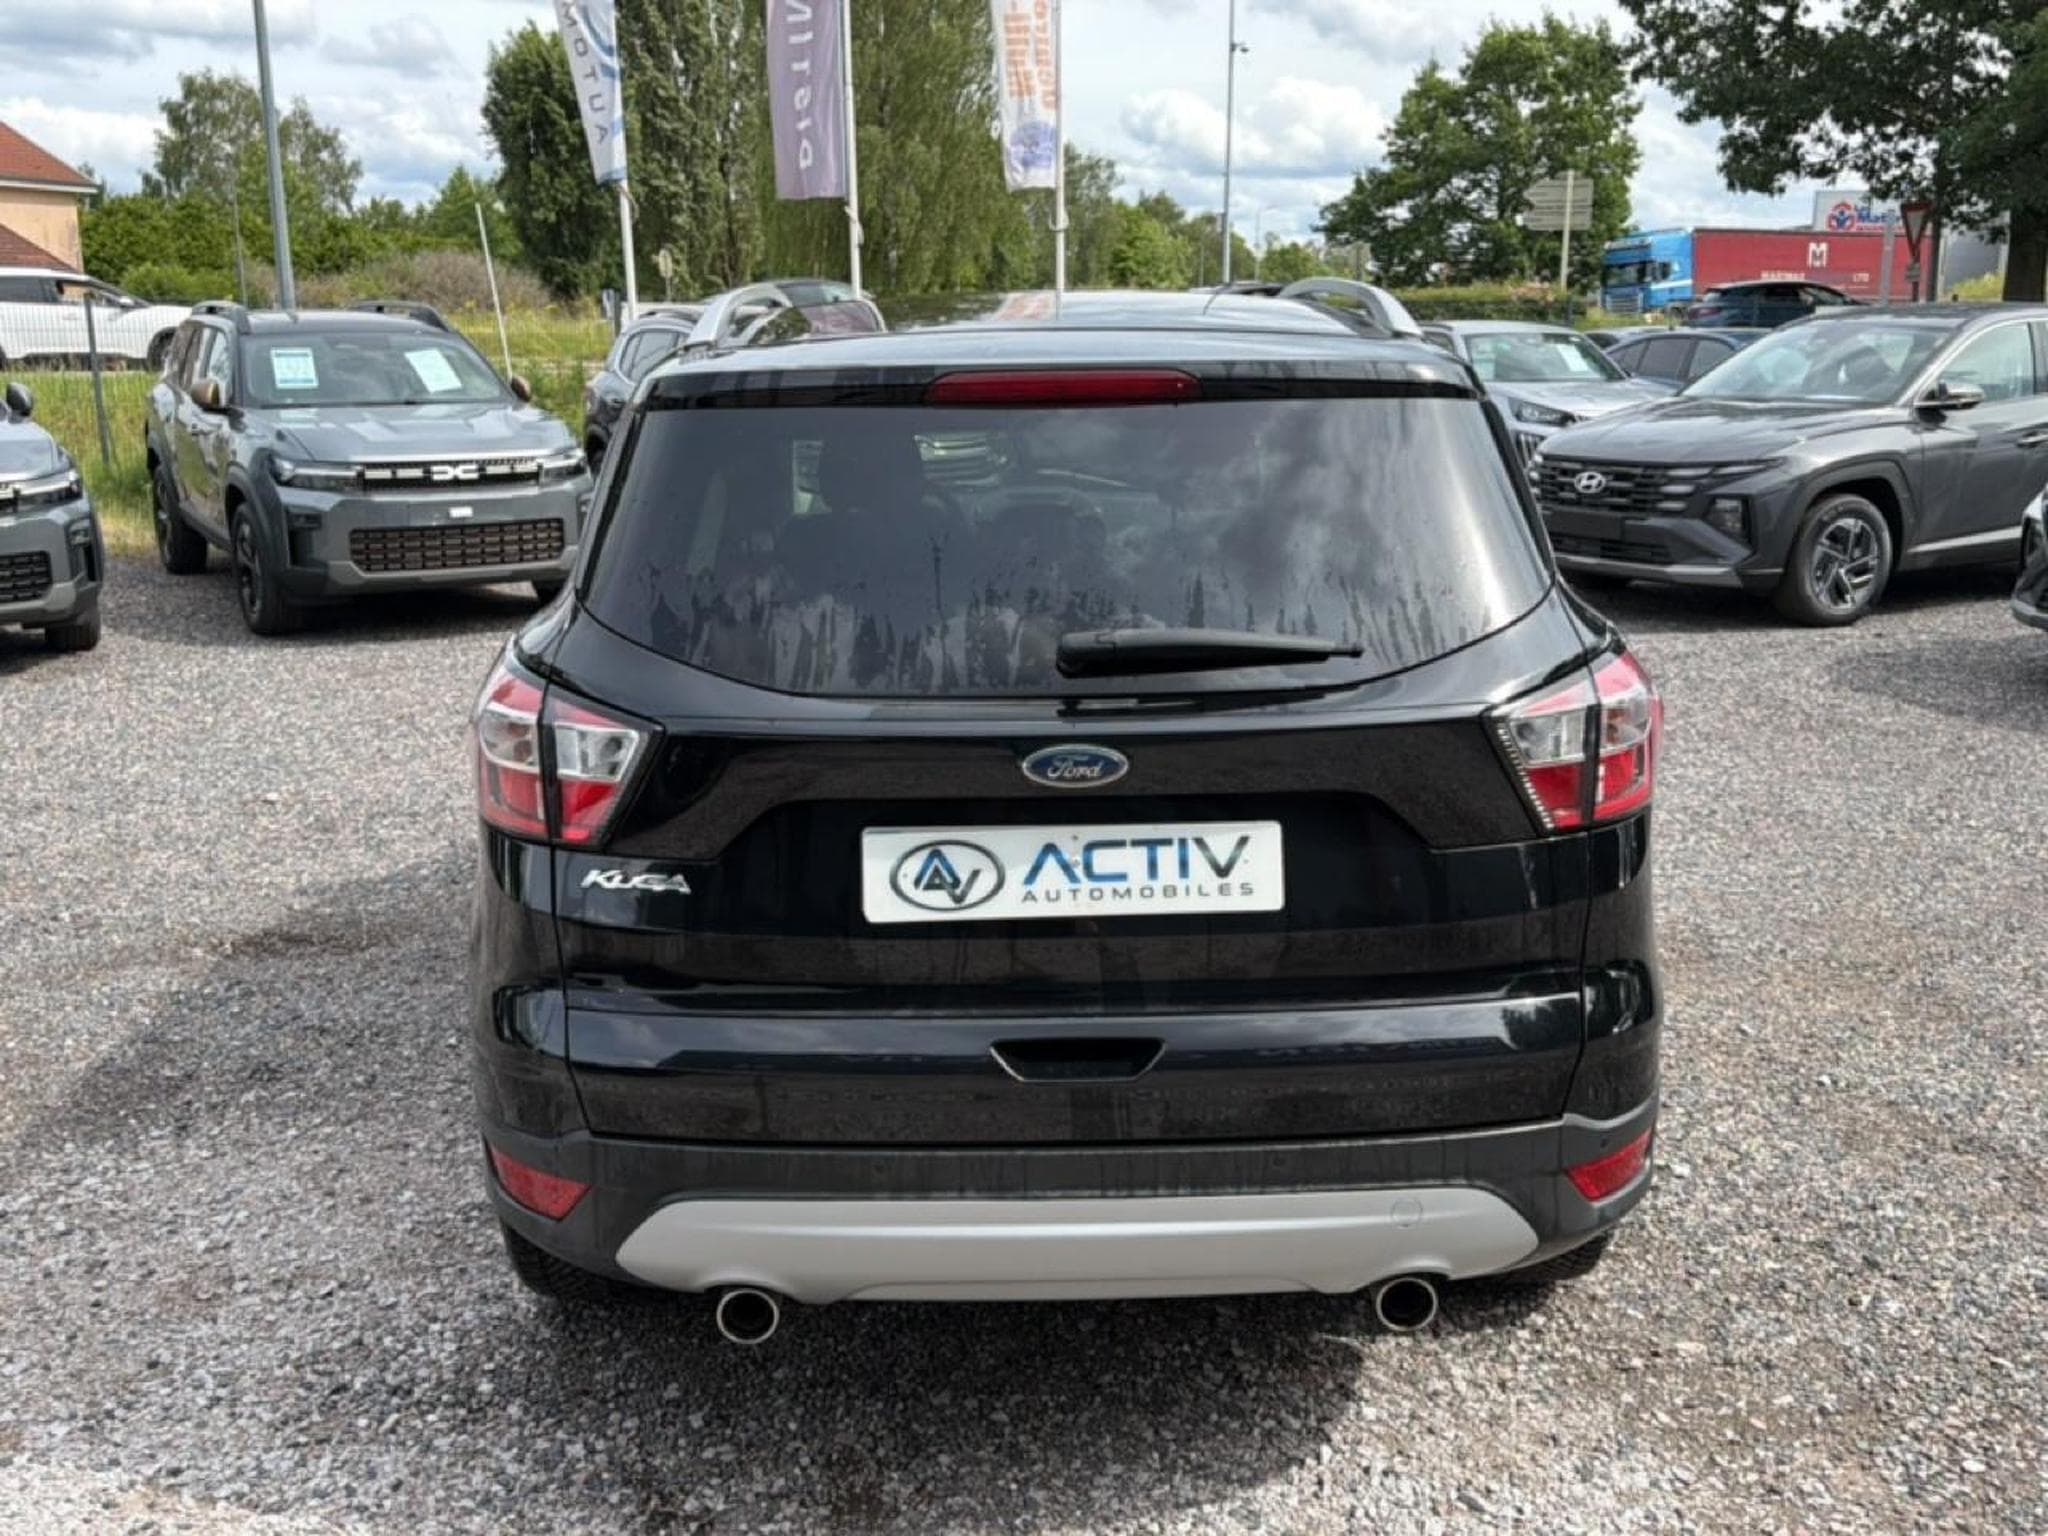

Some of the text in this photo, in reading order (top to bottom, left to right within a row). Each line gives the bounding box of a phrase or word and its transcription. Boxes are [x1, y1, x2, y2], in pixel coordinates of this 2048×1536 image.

[1047, 754, 1104, 778] Ford
[1023, 835, 1250, 886] ACTIV
[580, 869, 691, 894] KUGA
[1021, 881, 1255, 904] AUTOMOBILES
